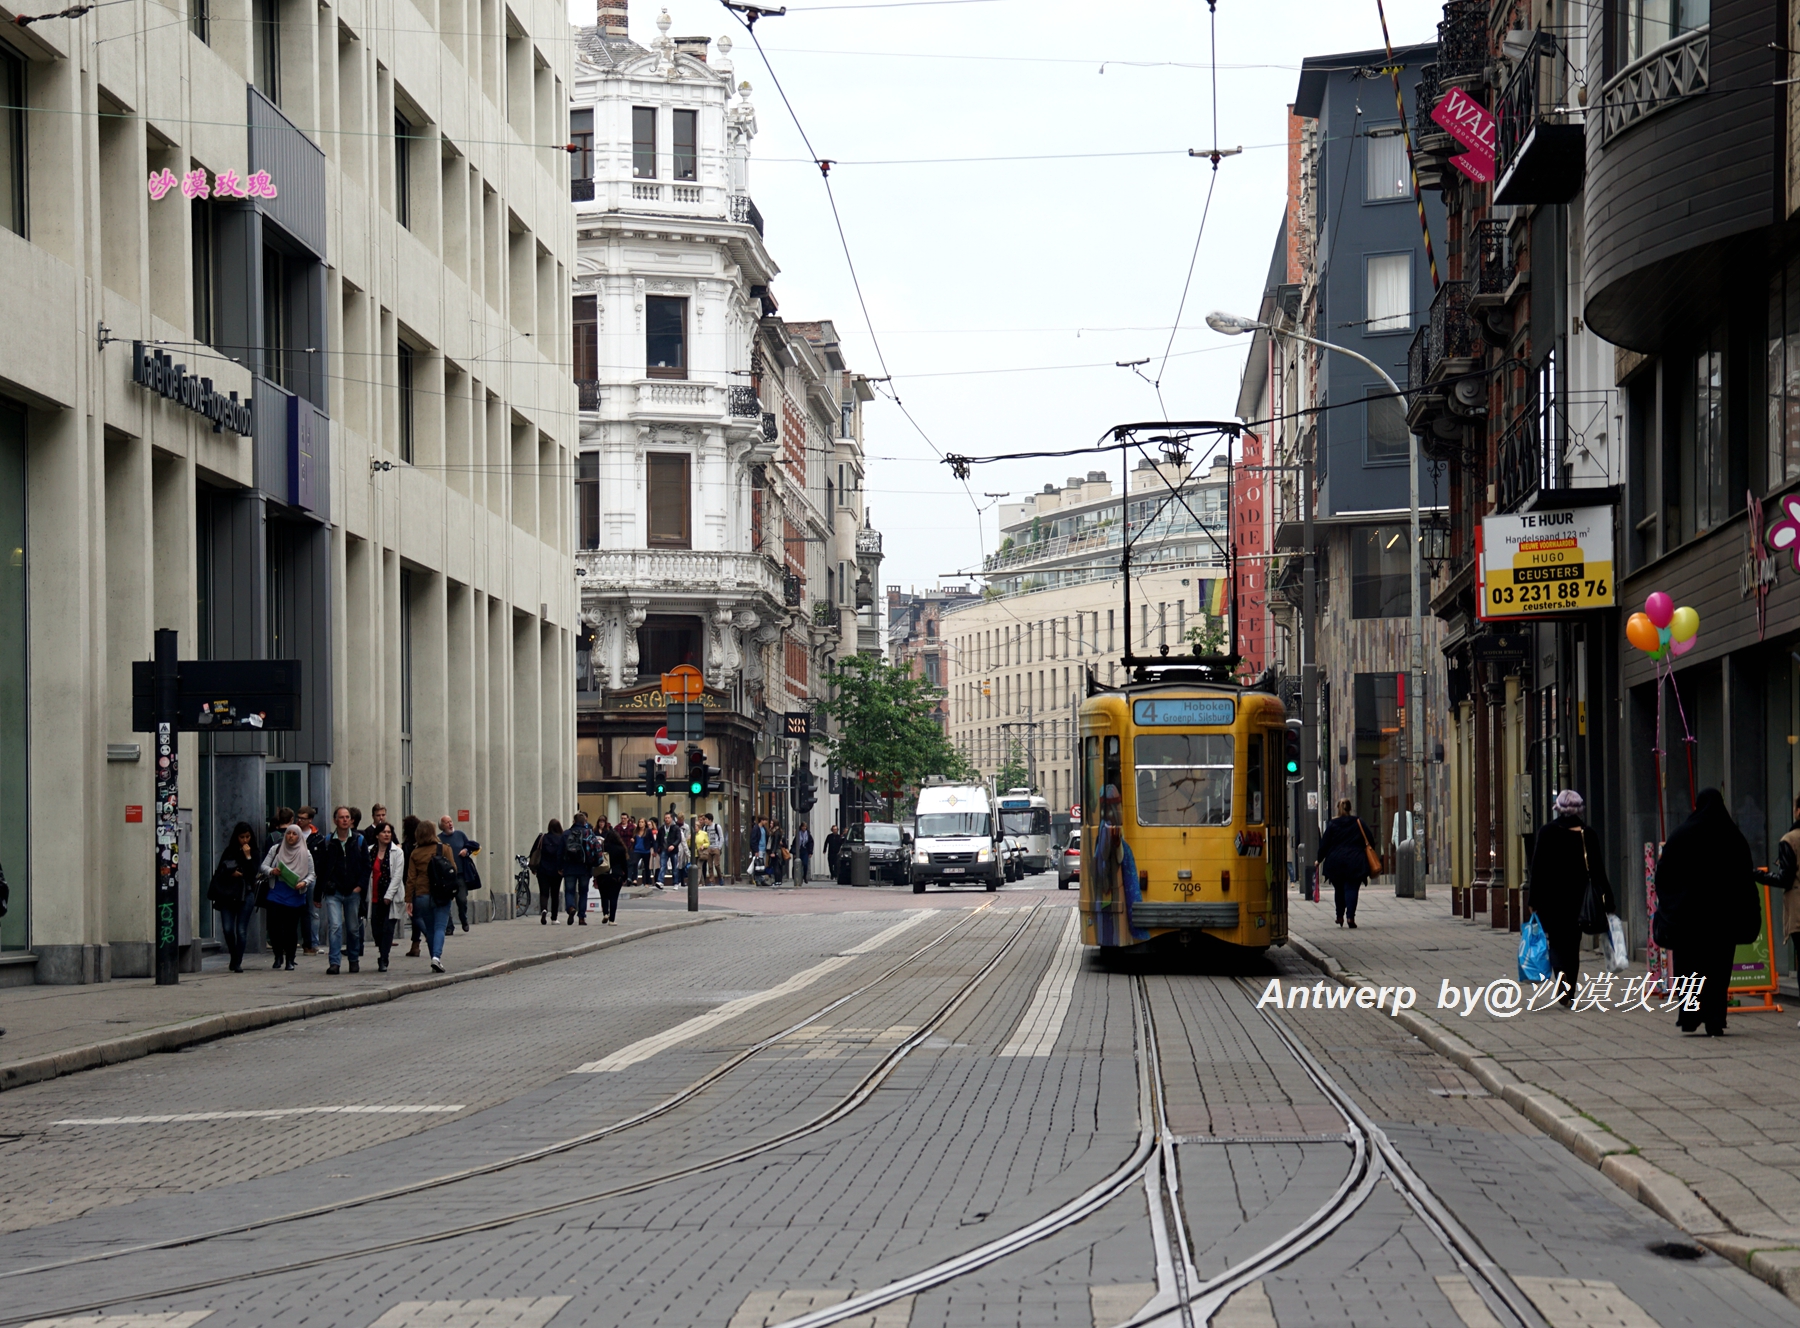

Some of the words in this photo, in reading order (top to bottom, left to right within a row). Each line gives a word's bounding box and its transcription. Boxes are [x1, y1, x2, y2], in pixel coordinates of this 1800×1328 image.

[1446, 91, 1495, 151] WAL
[1442, 114, 1495, 162] vastgoedmake
[133, 340, 164, 393] Karel
[174, 364, 252, 435] Grote-Hogeschoo
[1520, 515, 1536, 528] TE
[1539, 512, 1574, 527] HUUR
[1505, 531, 1560, 544] Handelspand
[1562, 530, 1577, 539] 123
[1520, 541, 1539, 551] NIEUWE
[1532, 552, 1564, 563] HUGO
[1518, 566, 1579, 580] CEUSTERS
[1492, 587, 1514, 604] 03
[1519, 584, 1550, 602] 231
[1557, 582, 1580, 599] 88
[1584, 579, 1607, 597] 76
[1523, 600, 1577, 611] ceusters.be
[1141, 702, 1158, 722] 4
[1184, 701, 1231, 711] Hoboken
[1163, 713, 1197, 723] Groenpl.
[788, 717, 806, 726] NOA
[788, 725, 806, 733] NOA
[1173, 883, 1202, 892] 7006
